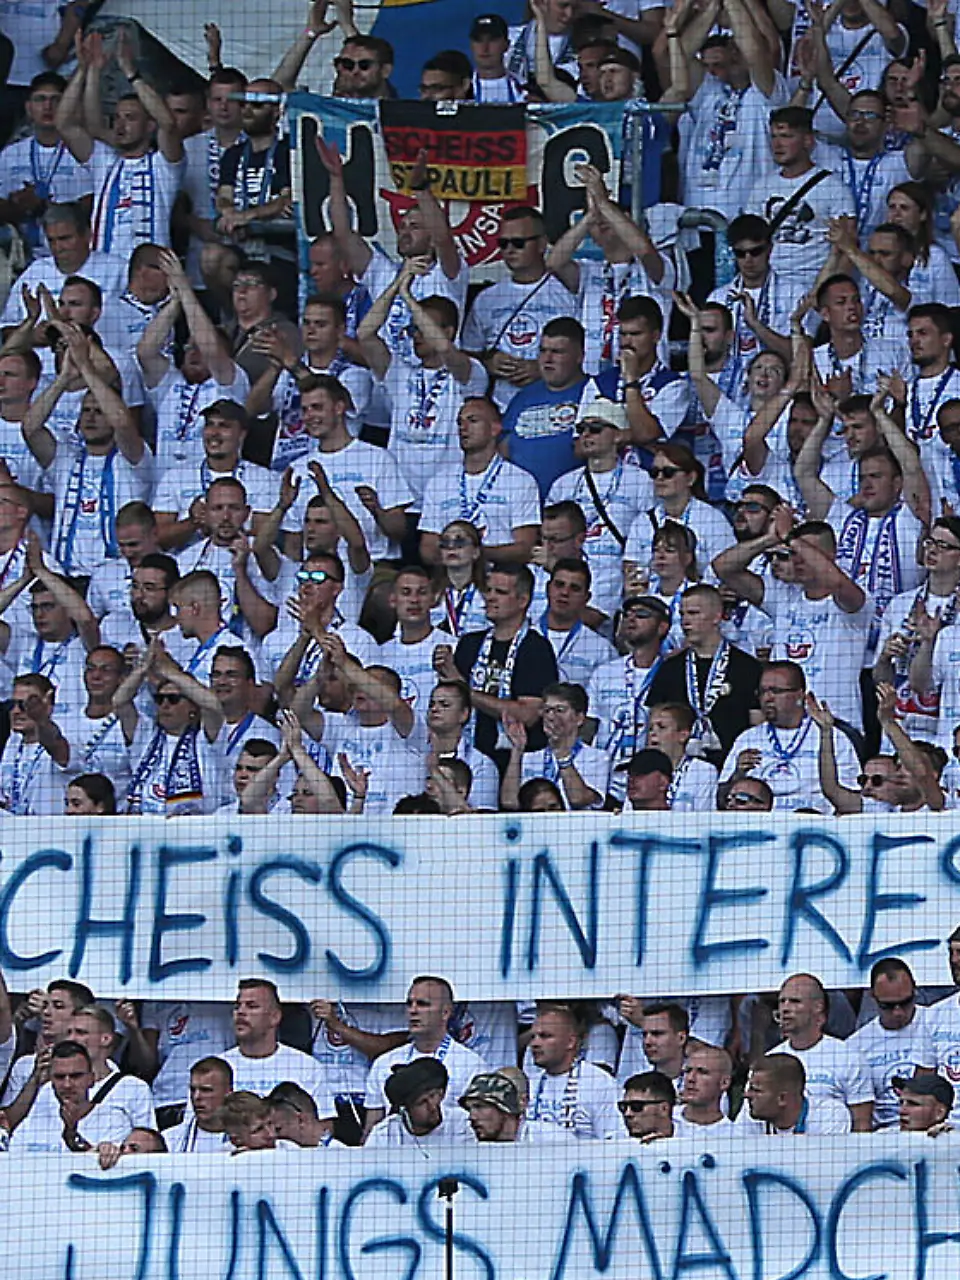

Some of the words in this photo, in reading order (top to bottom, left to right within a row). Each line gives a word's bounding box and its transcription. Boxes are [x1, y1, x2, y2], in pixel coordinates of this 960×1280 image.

[386, 131, 516, 162] SCHEISS
[427, 167, 512, 196] PAULI
[0, 833, 402, 984] CHEiSS
